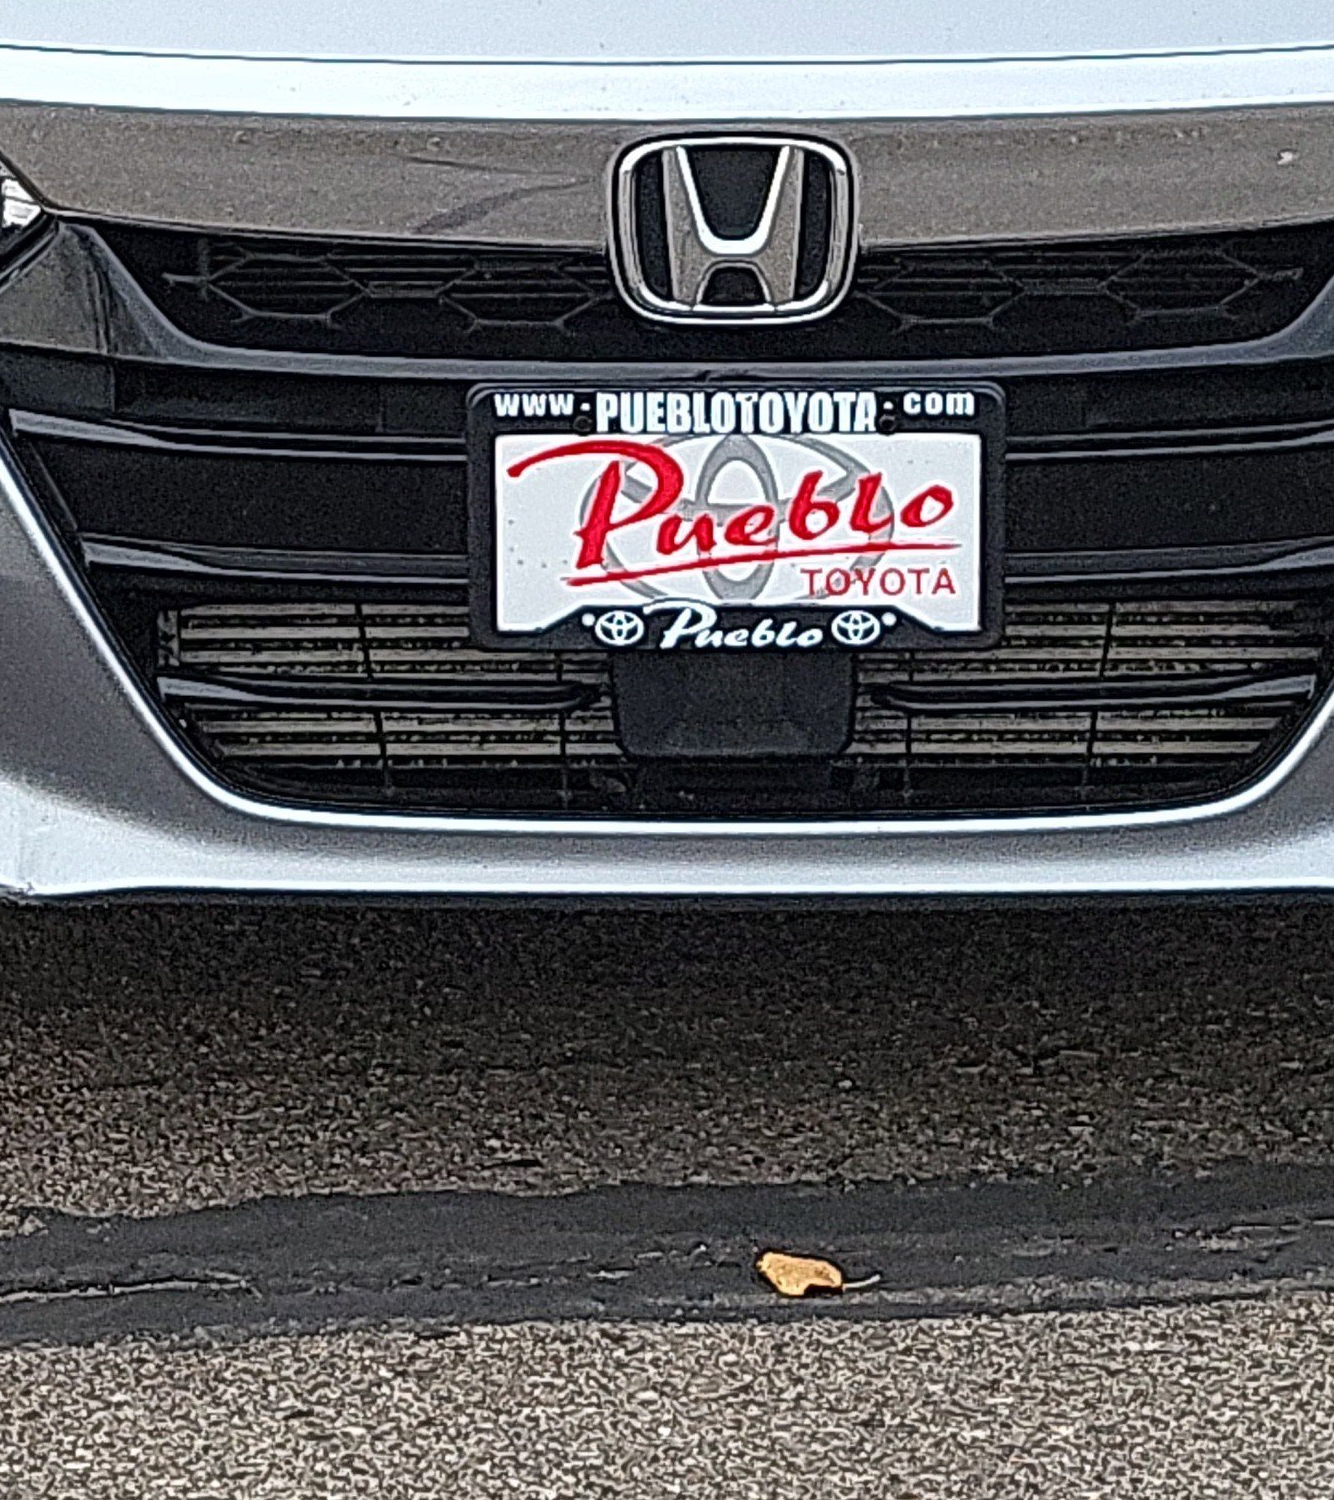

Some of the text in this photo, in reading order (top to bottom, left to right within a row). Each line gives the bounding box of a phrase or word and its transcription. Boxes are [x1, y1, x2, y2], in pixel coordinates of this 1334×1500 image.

[507, 439, 955, 570] Pueblo
[800, 567, 956, 596] TOYOTA
[643, 601, 824, 649] Pueblo
